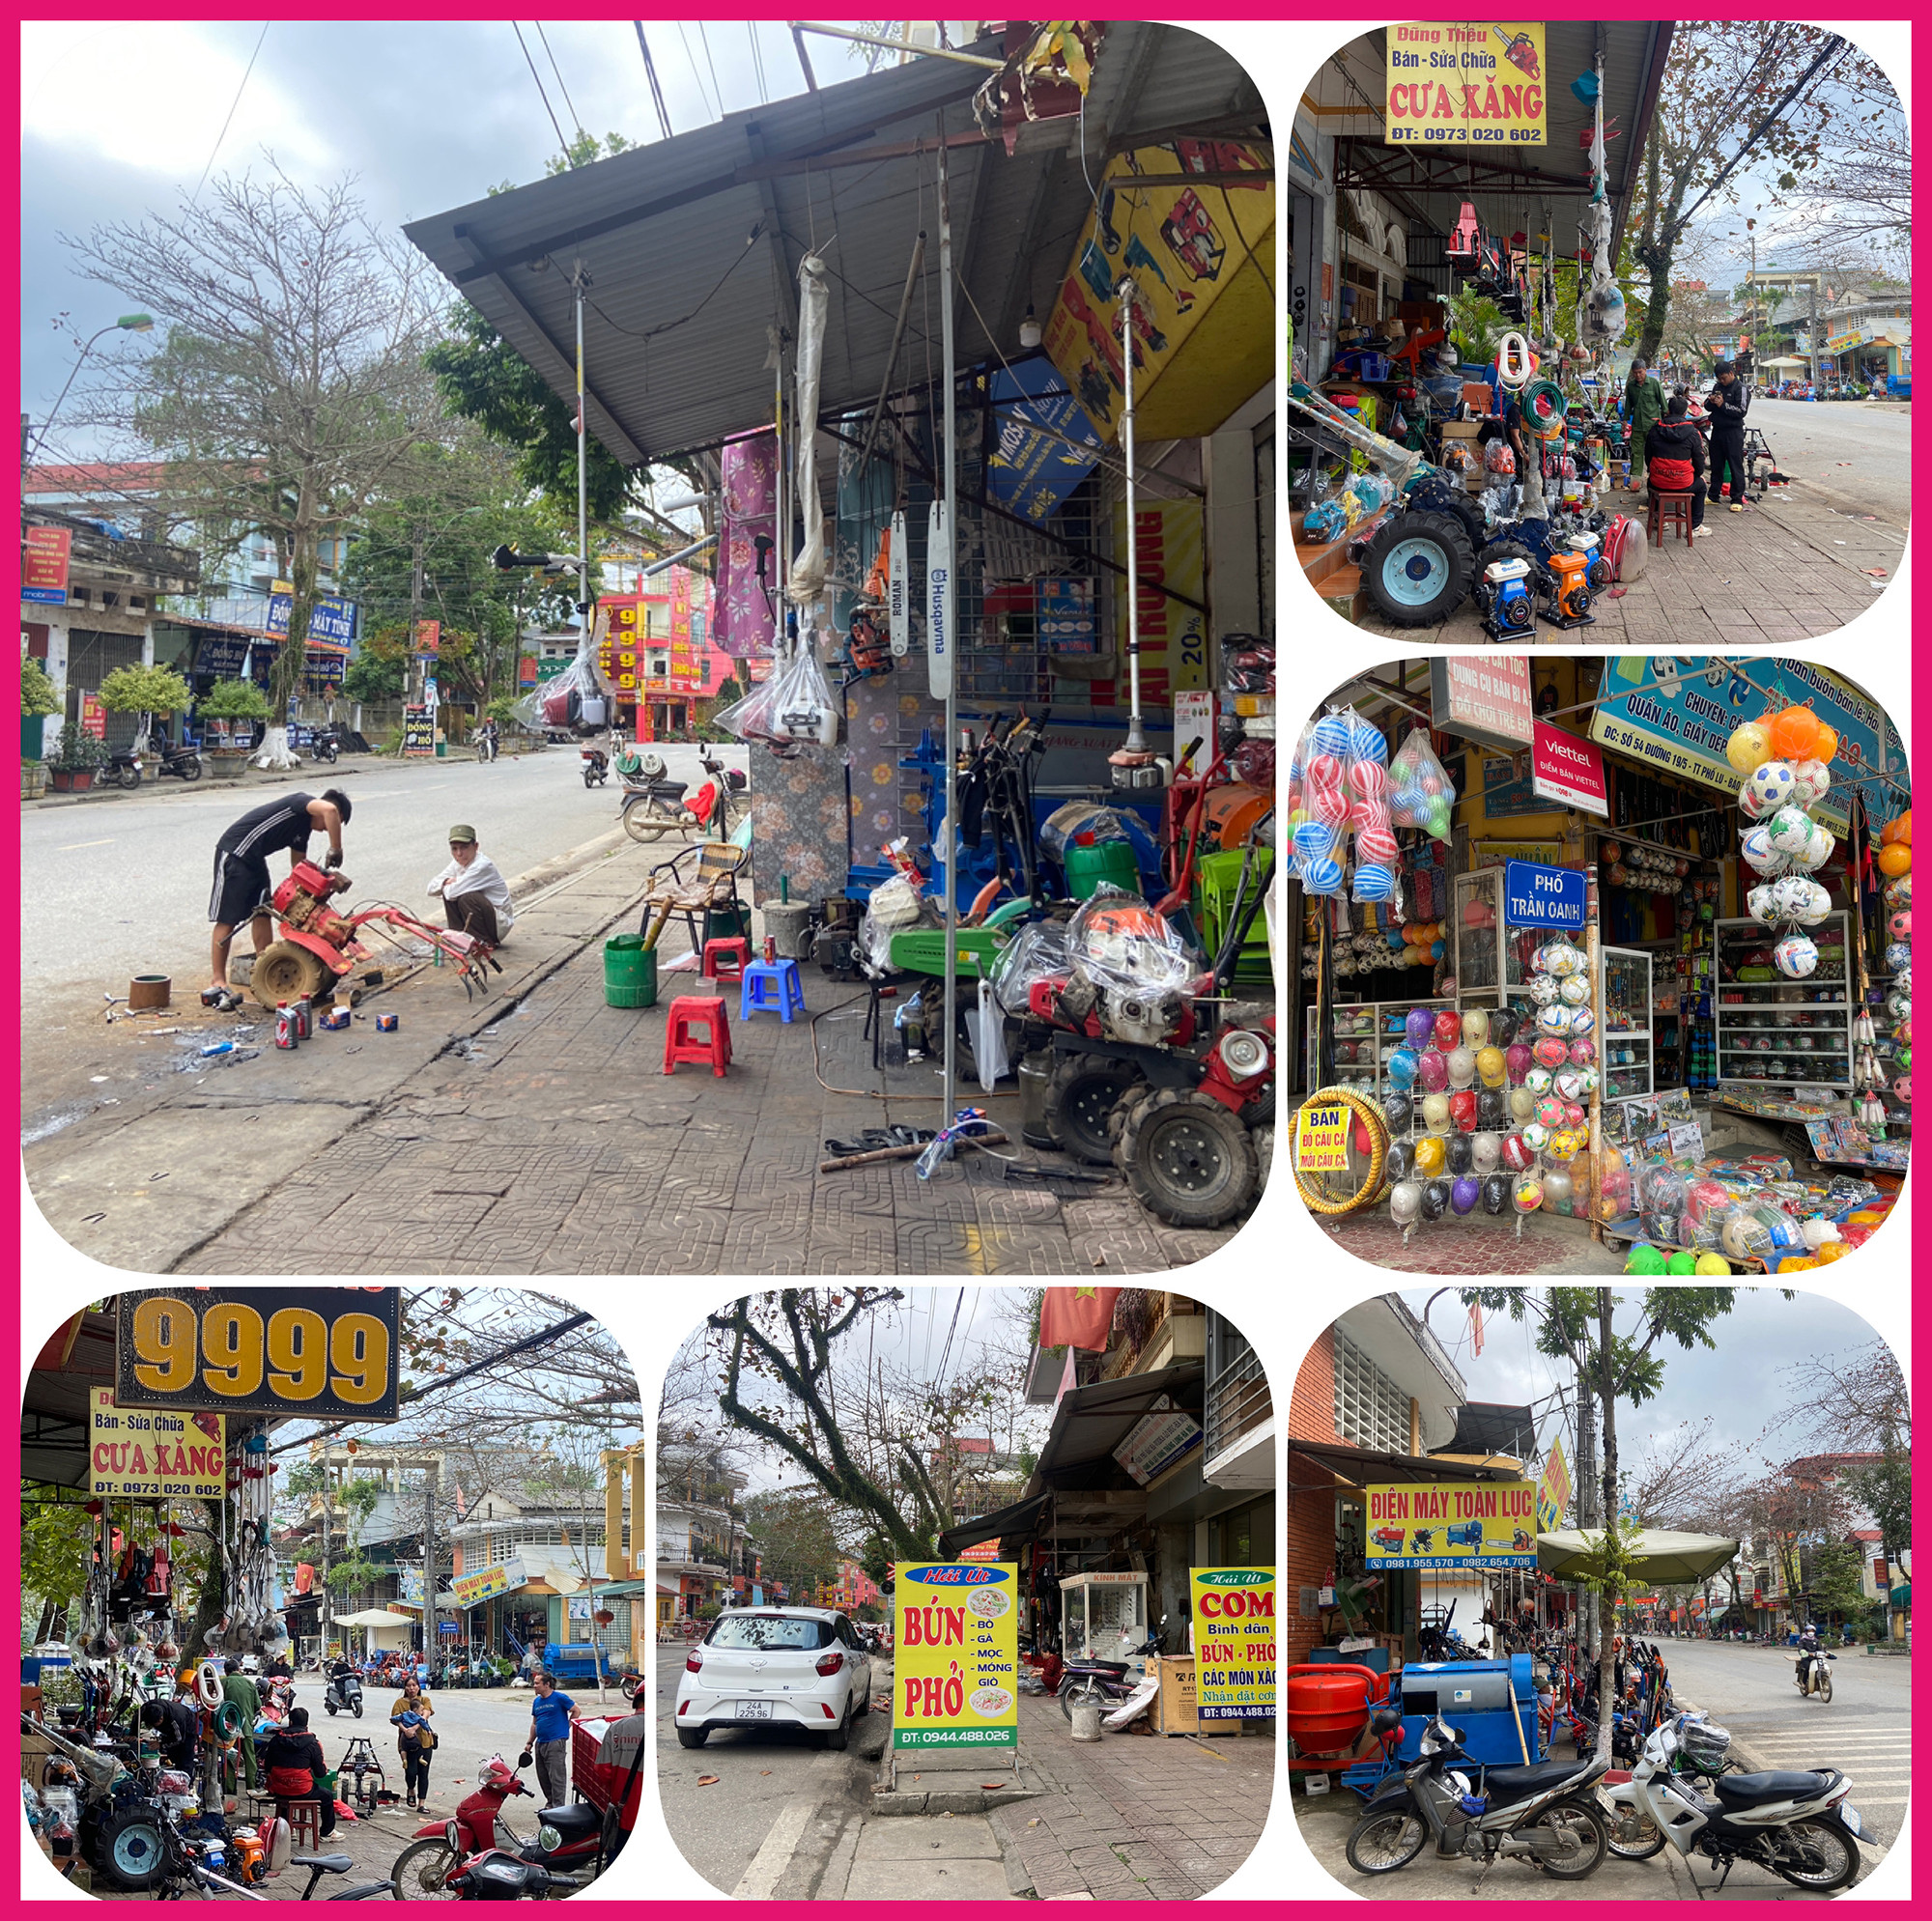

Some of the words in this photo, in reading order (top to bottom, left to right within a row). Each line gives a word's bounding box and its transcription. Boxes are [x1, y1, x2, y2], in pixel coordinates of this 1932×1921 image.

[1392, 51, 1419, 67] Bán
[1429, 51, 1456, 69] Sửa
[1462, 52, 1496, 69] Chữa
[1390, 80, 1454, 118] CƯA
[1461, 74, 1543, 120] XĂNG
[1392, 128, 1418, 140] ĐT:
[1424, 128, 1467, 140] 0973
[1472, 129, 1503, 141] 020
[1510, 129, 1541, 141] 602
[893, 580, 902, 616] ROMAN
[1181, 616, 1202, 665] 20%
[1453, 663, 1478, 688] DỤNG
[1480, 673, 1492, 697] CỤ
[1512, 684, 1521, 703] BI
[1523, 689, 1528, 706] A
[1808, 668, 1835, 699] buôn
[1835, 687, 1854, 713] bán
[1854, 701, 1866, 722] lẻ:
[1626, 693, 1662, 725] QUẦN
[1661, 707, 1680, 736] ÁO,
[1685, 692, 1728, 727] CHUYÊN:
[1497, 708, 1515, 730] TRẺ
[1518, 717, 1529, 734] EM
[1604, 725, 1619, 742] ĐC:
[1620, 731, 1635, 747] SỐ
[1634, 738, 1644, 752] 54
[1644, 743, 1671, 764] ĐƯỜNG
[1672, 754, 1688, 769] 19/5
[1692, 763, 1701, 774] TT
[1715, 774, 1725, 785] LU
[1540, 761, 1557, 774] ĐIỂM
[1559, 768, 1573, 780] BÁN
[1575, 774, 1600, 790] VIETTEL
[1535, 871, 1564, 893] PHỐ
[1511, 890, 1544, 917] TRẦN
[1548, 901, 1580, 920] OANH
[1310, 1109, 1339, 1126] BÁN
[1315, 1131, 1331, 1146] CÂU
[1334, 1130, 1345, 1146] CÁ
[1335, 1151, 1345, 1166] CÁ
[133, 1296, 389, 1404] 9999
[95, 1413, 118, 1428] Bán
[127, 1414, 150, 1430] Sửa
[154, 1416, 185, 1432] Chữa
[93, 1440, 148, 1475] CƯA
[153, 1436, 224, 1476] XĂNG
[95, 1482, 118, 1493] ĐT:
[123, 1483, 159, 1493] 0973
[164, 1483, 190, 1494] 020
[195, 1485, 222, 1495] 602
[1371, 1487, 1409, 1525] ĐIỆN
[1414, 1486, 1450, 1519] MÁY
[1454, 1485, 1497, 1518] TOÀN
[1502, 1489, 1533, 1523] LỤC
[1385, 1558, 1454, 1568] 0981.955.570
[1462, 1557, 1530, 1567] 0982.654.706
[923, 1568, 962, 1583] Hải
[966, 1566, 991, 1582] Út
[1199, 1589, 1275, 1619] CƠM
[903, 1595, 966, 1647] BÚN
[978, 1619, 994, 1629] BÒ
[1208, 1624, 1239, 1635] Bình
[1244, 1623, 1270, 1634] dân
[977, 1633, 993, 1644] GÀ
[978, 1649, 1003, 1660] MỌC
[1201, 1639, 1234, 1663] BÚN
[978, 1662, 1012, 1673] MÓNG
[1203, 1668, 1225, 1686] CÁC
[1228, 1668, 1254, 1685] MÓN
[904, 1660, 964, 1718] PHỞ
[978, 1675, 998, 1687] GIÒ
[747, 1701, 761, 1709] 24A
[1203, 1691, 1234, 1704] Nhận
[1237, 1691, 1256, 1704] đặt
[1204, 1708, 1218, 1718] ĐT:
[902, 1732, 920, 1743] ĐT:
[923, 1731, 1010, 1742] 0944.488.026
